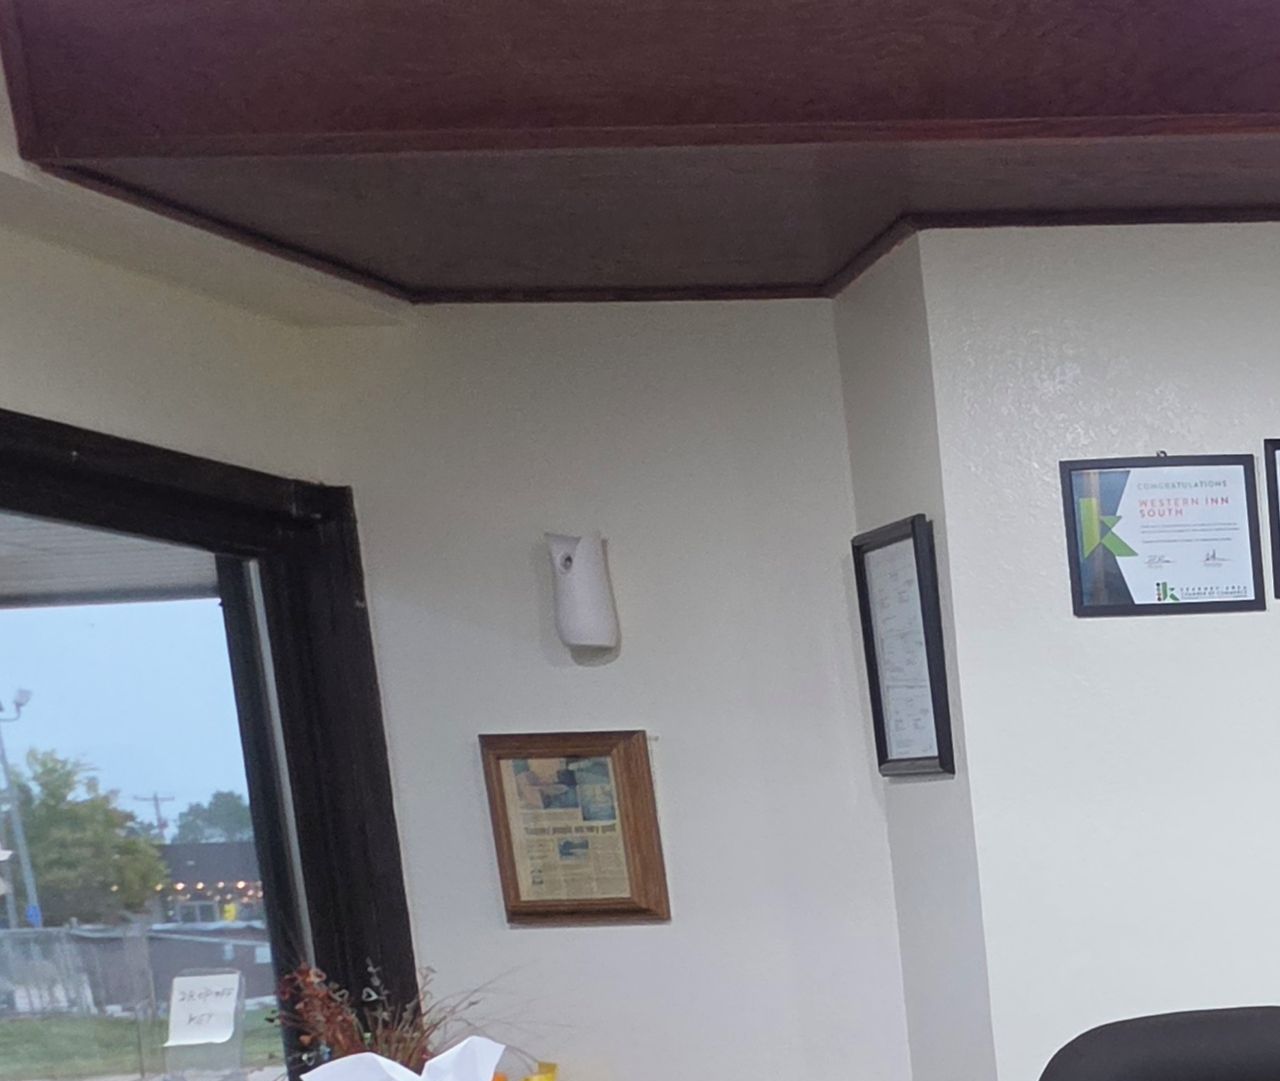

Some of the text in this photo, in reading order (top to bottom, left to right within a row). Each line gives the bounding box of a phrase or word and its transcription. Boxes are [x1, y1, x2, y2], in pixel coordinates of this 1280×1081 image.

[1137, 480, 1227, 490] CONGRATULATIONS
[1138, 497, 1229, 507] WESTERN INN
[1139, 508, 1183, 518] SOUTH
